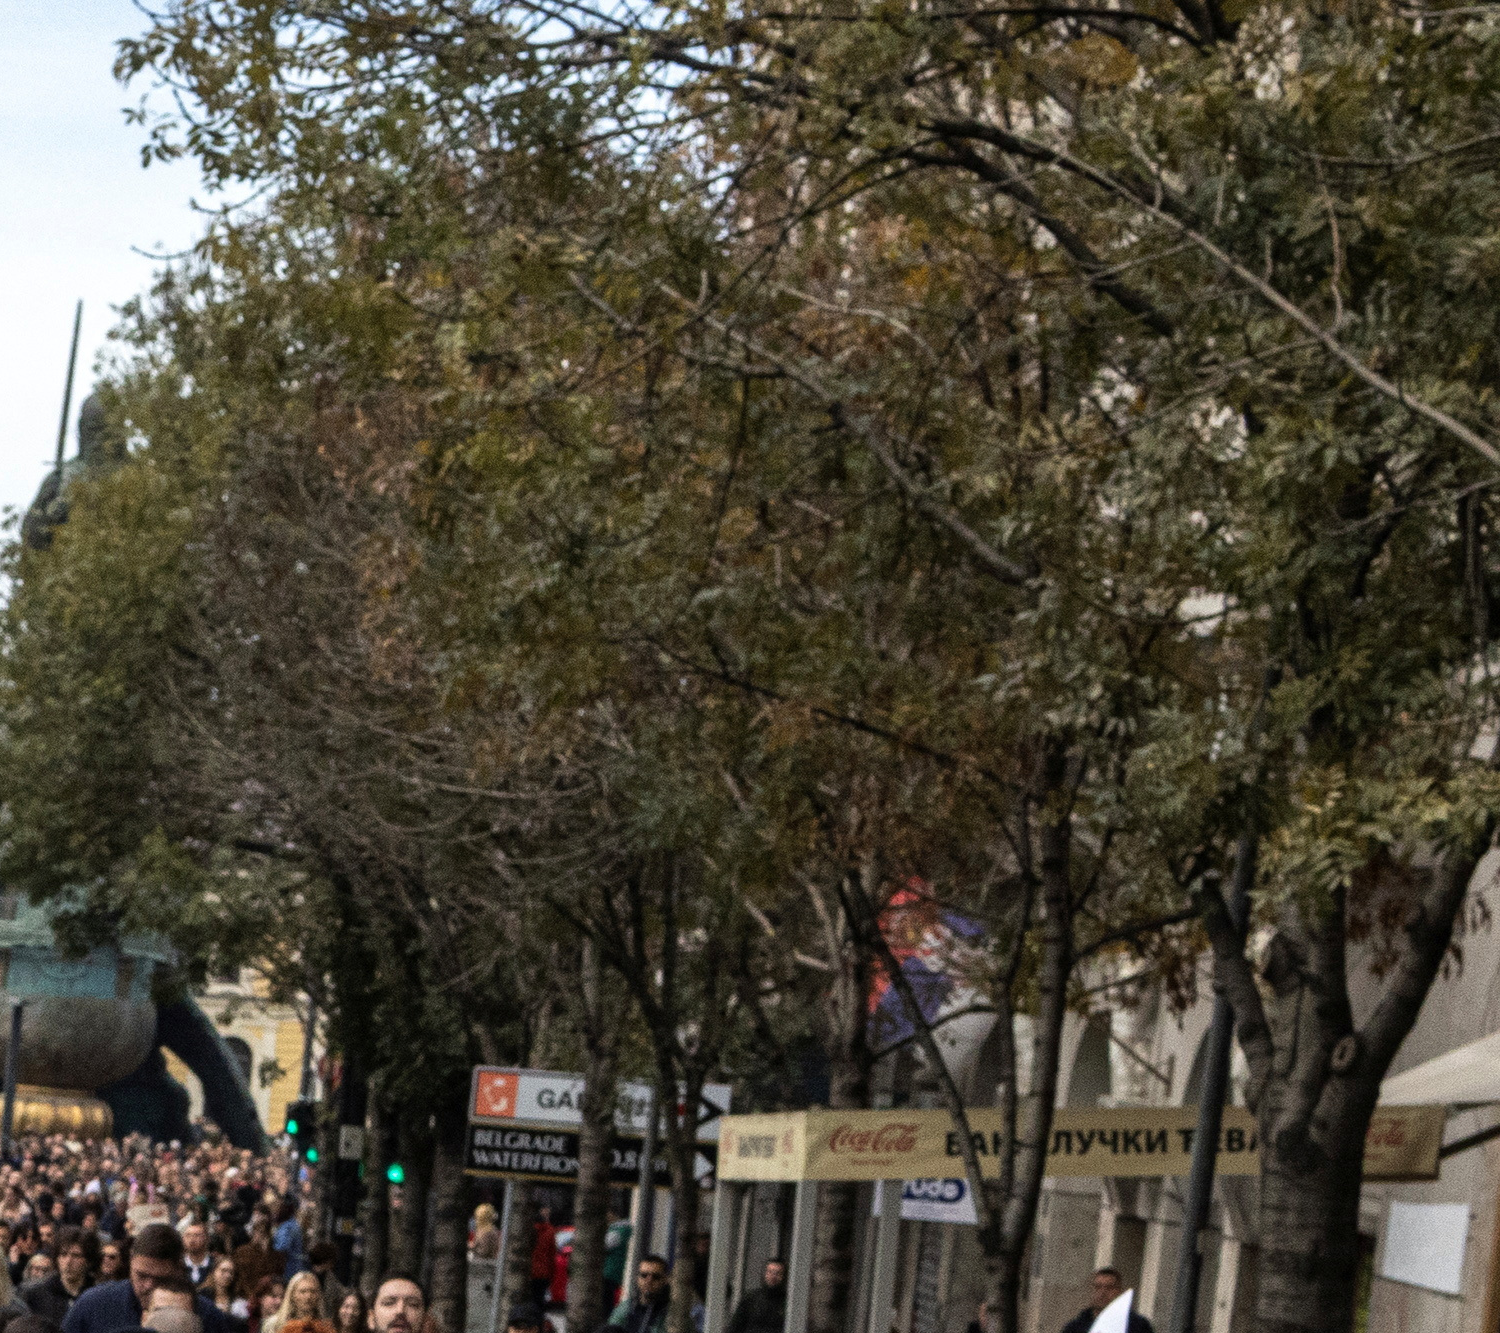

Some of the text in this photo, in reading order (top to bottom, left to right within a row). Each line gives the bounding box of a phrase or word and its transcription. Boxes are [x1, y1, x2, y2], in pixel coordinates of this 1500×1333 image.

[473, 1129, 567, 1153] BELGRADE
[829, 1123, 920, 1154] Coca-Cola
[945, 1129, 1168, 1157] БАЛУЧКИ
